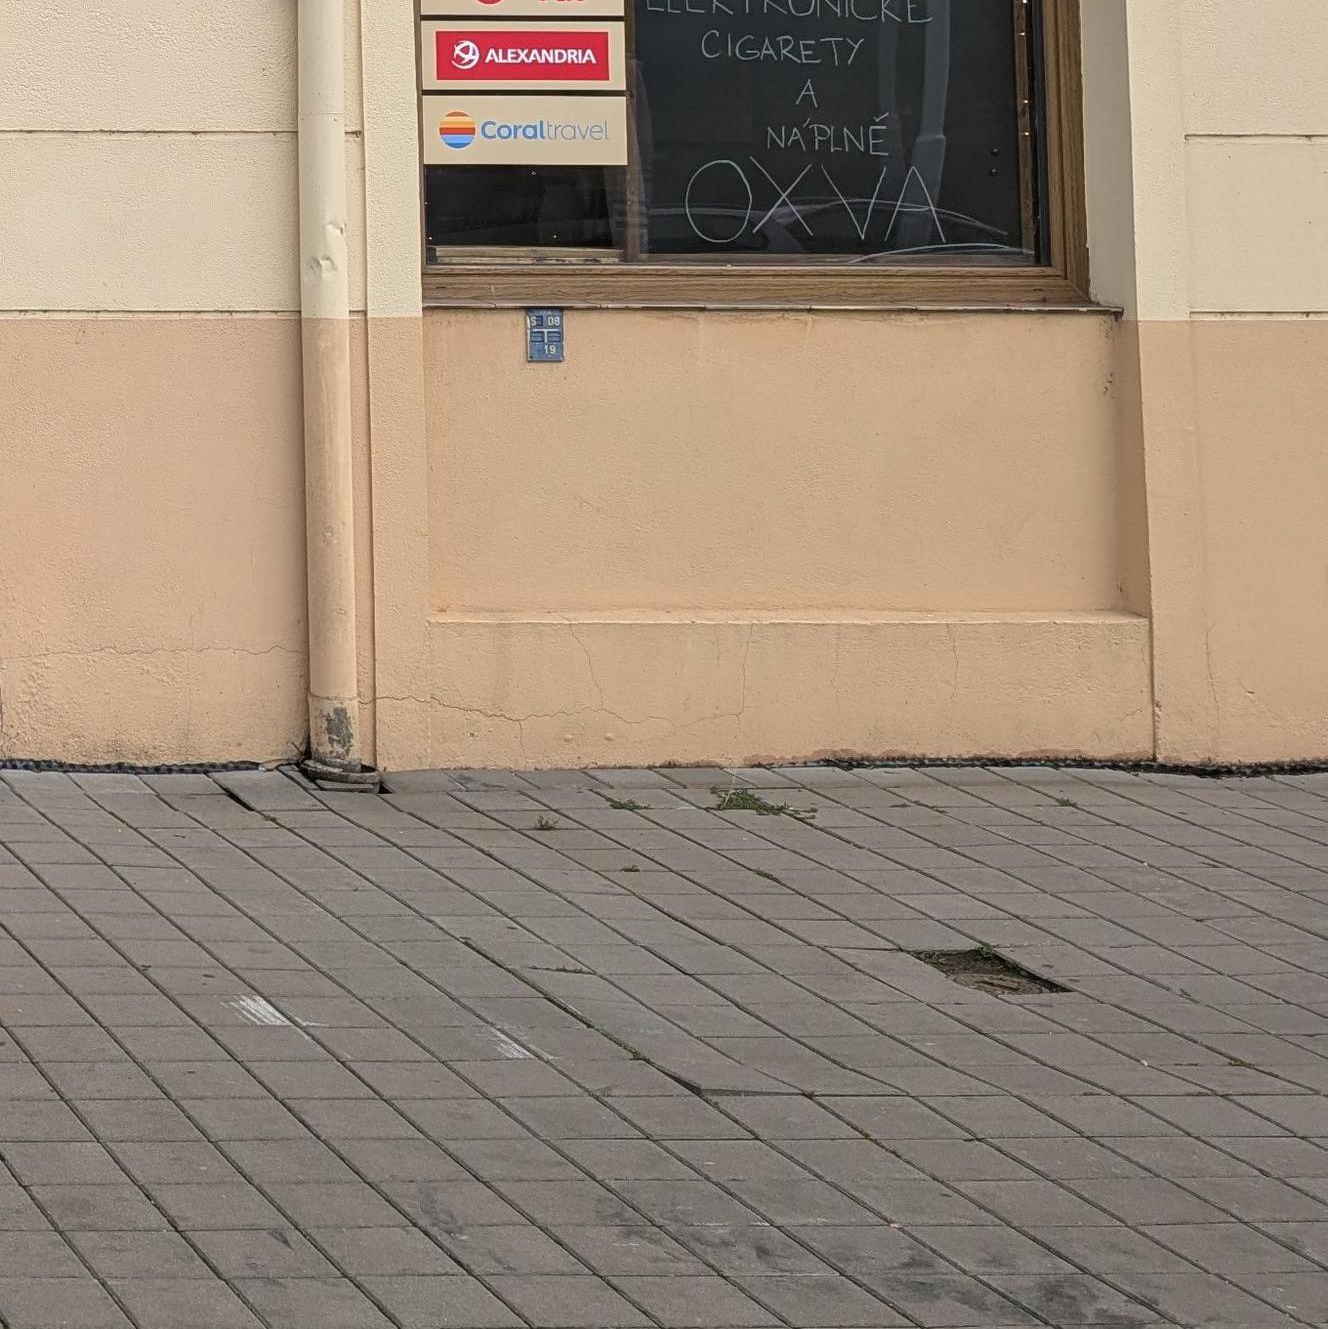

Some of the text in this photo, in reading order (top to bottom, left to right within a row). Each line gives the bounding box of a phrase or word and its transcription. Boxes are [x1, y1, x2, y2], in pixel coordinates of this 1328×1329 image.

[484, 48, 597, 65] ALEXANDRIA
[701, 30, 866, 66] CIGARETY
[795, 78, 818, 109] A
[480, 119, 610, 143] Coraltravel
[766, 112, 891, 157] NÁPLNĚ
[685, 156, 947, 244] OXVA
